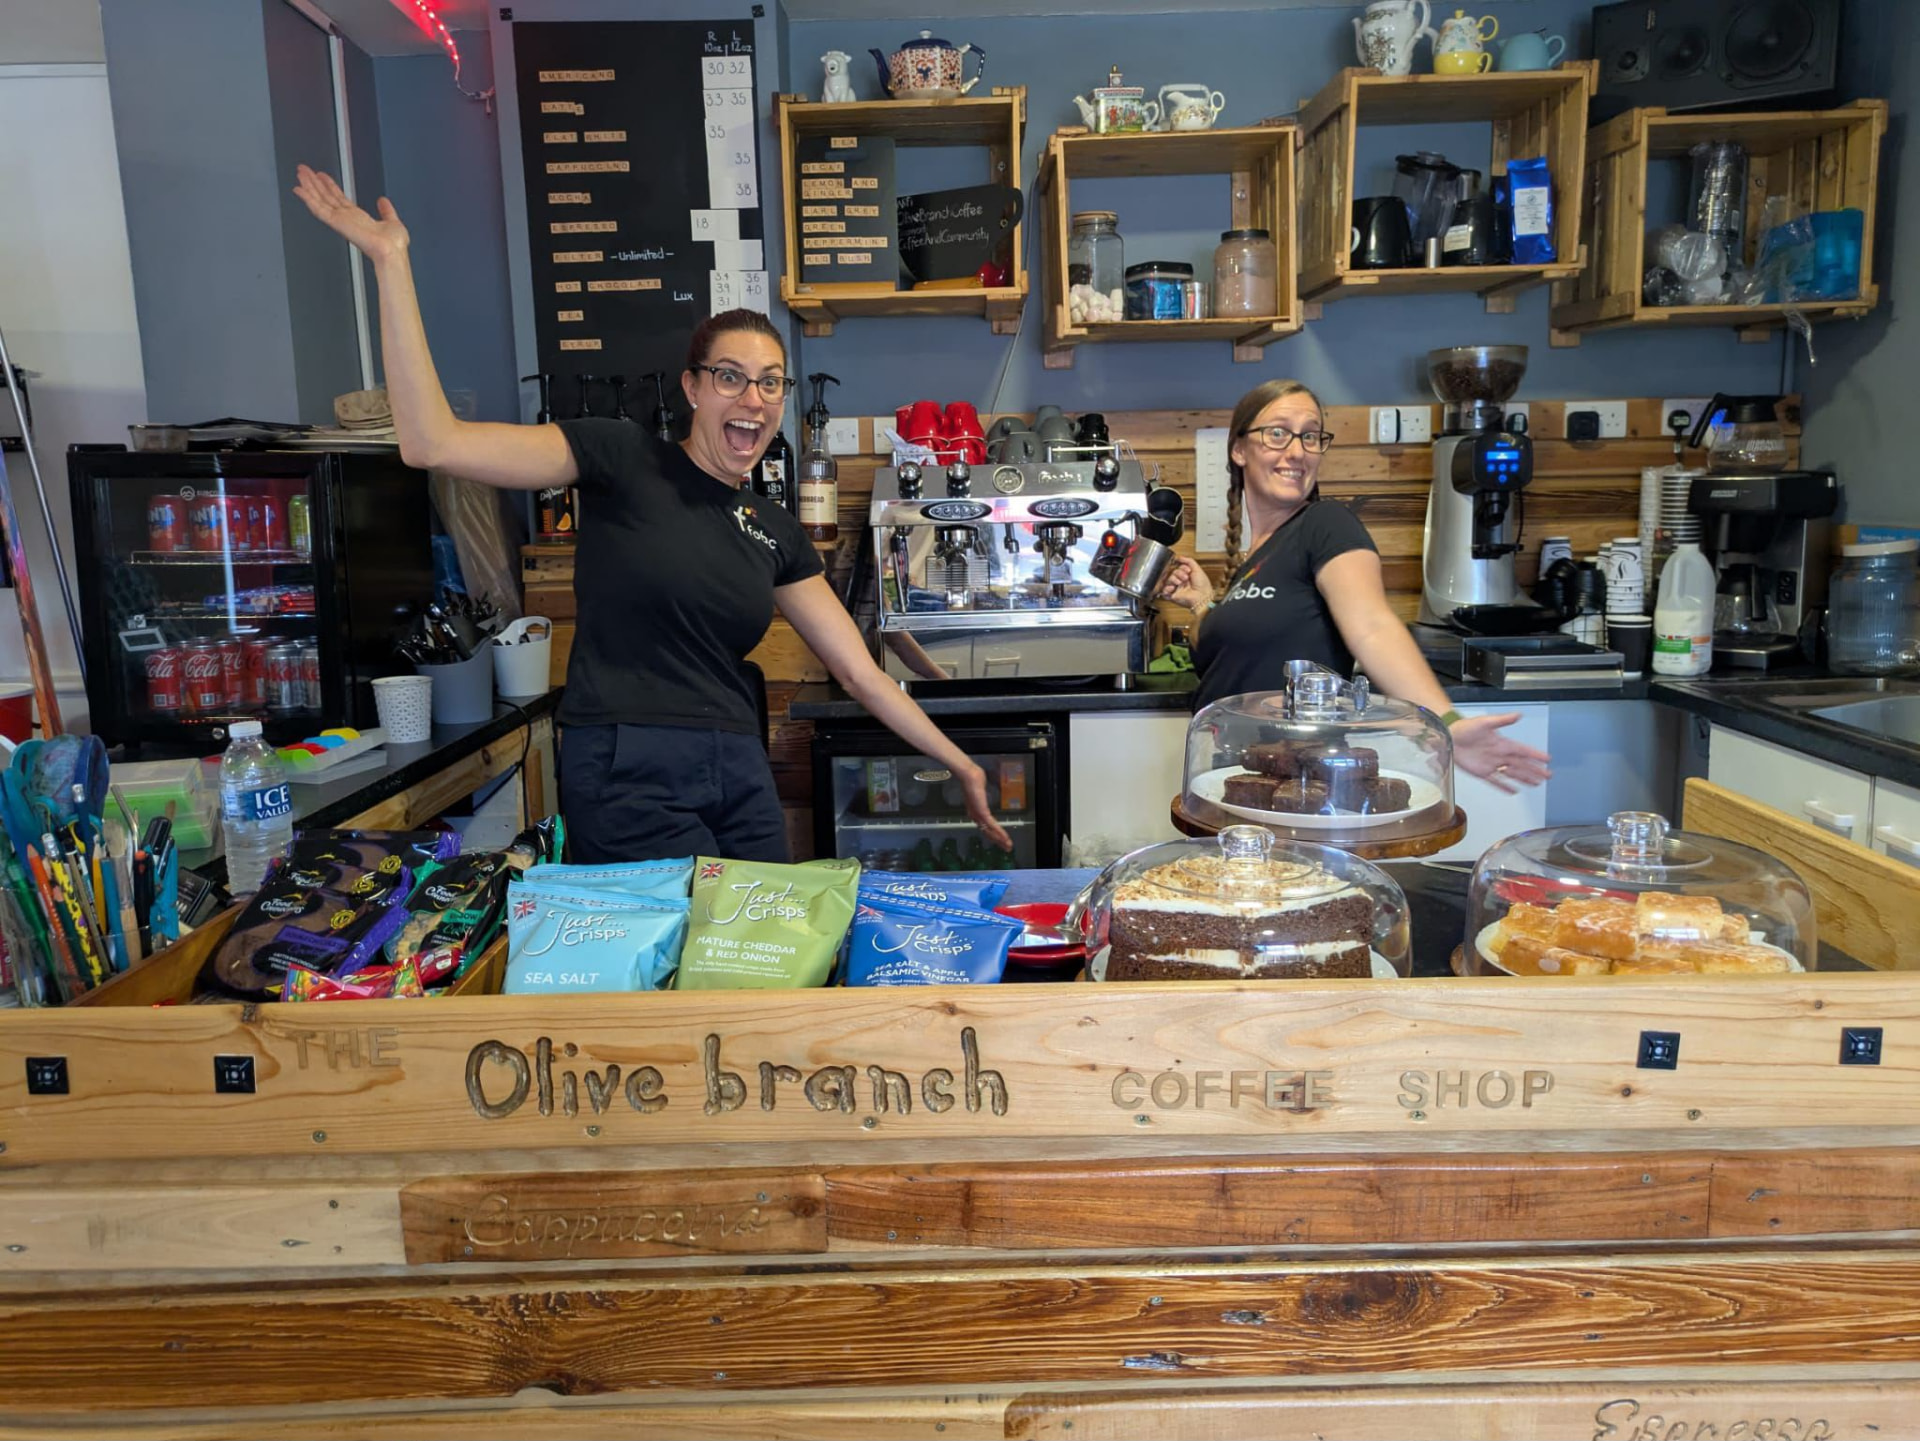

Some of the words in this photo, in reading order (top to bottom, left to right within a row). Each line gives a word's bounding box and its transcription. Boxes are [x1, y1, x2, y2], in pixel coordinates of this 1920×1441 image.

[707, 31, 717, 41] R
[732, 30, 741, 41] L
[540, 70, 614, 81] AMERICANO
[542, 103, 583, 114] LATTE
[544, 132, 577, 142] FLAT
[585, 131, 626, 141] WHITE
[831, 138, 857, 147] TEA
[547, 162, 629, 172] CAPPUCCINO
[803, 163, 844, 172] DECAF
[803, 180, 843, 188] LEMON
[853, 179, 877, 188] AND
[549, 193, 590, 203] MOCHA
[804, 189, 852, 198] GINGER
[804, 207, 836, 215] EARL
[845, 206, 878, 215] GREY
[551, 222, 617, 232] ESPRESSO
[804, 223, 844, 231] GREEN
[804, 238, 887, 248] PEPPERMINT
[554, 252, 603, 262] FILTER
[805, 255, 829, 264] RED
[838, 254, 870, 263] BUSH
[556, 282, 581, 292] HOT
[588, 279, 661, 291] CHOCOLATE
[674, 291, 694, 301] Lux
[558, 311, 583, 320] TEA
[561, 340, 601, 349] SYRUP
[185, 653, 222, 678] Cola
[255, 785, 289, 810] ICE
[256, 804, 290, 819] VALLEY
[745, 905, 806, 921] Crisps
[562, 929, 627, 946] Crisps
[696, 936, 741, 949] MATURE
[742, 941, 797, 955] CHEDDAR
[914, 941, 973, 956] Crisps
[705, 949, 714, 957] &
[716, 951, 738, 959] RED
[740, 952, 781, 964] ONION
[875, 963, 892, 971] SEA
[896, 960, 921, 968] SALT
[932, 968, 967, 977] APPLE
[523, 972, 554, 985] SEA
[558, 972, 600, 985] SALT
[866, 968, 919, 981] BALSAMIC
[921, 970, 971, 983] VINEGAR
[287, 1027, 401, 1070] THE
[465, 1036, 669, 1119] Olive
[703, 1026, 1009, 1116] branch
[1111, 1069, 1336, 1111] COFFEE
[1396, 1069, 1556, 1110] SHOP
